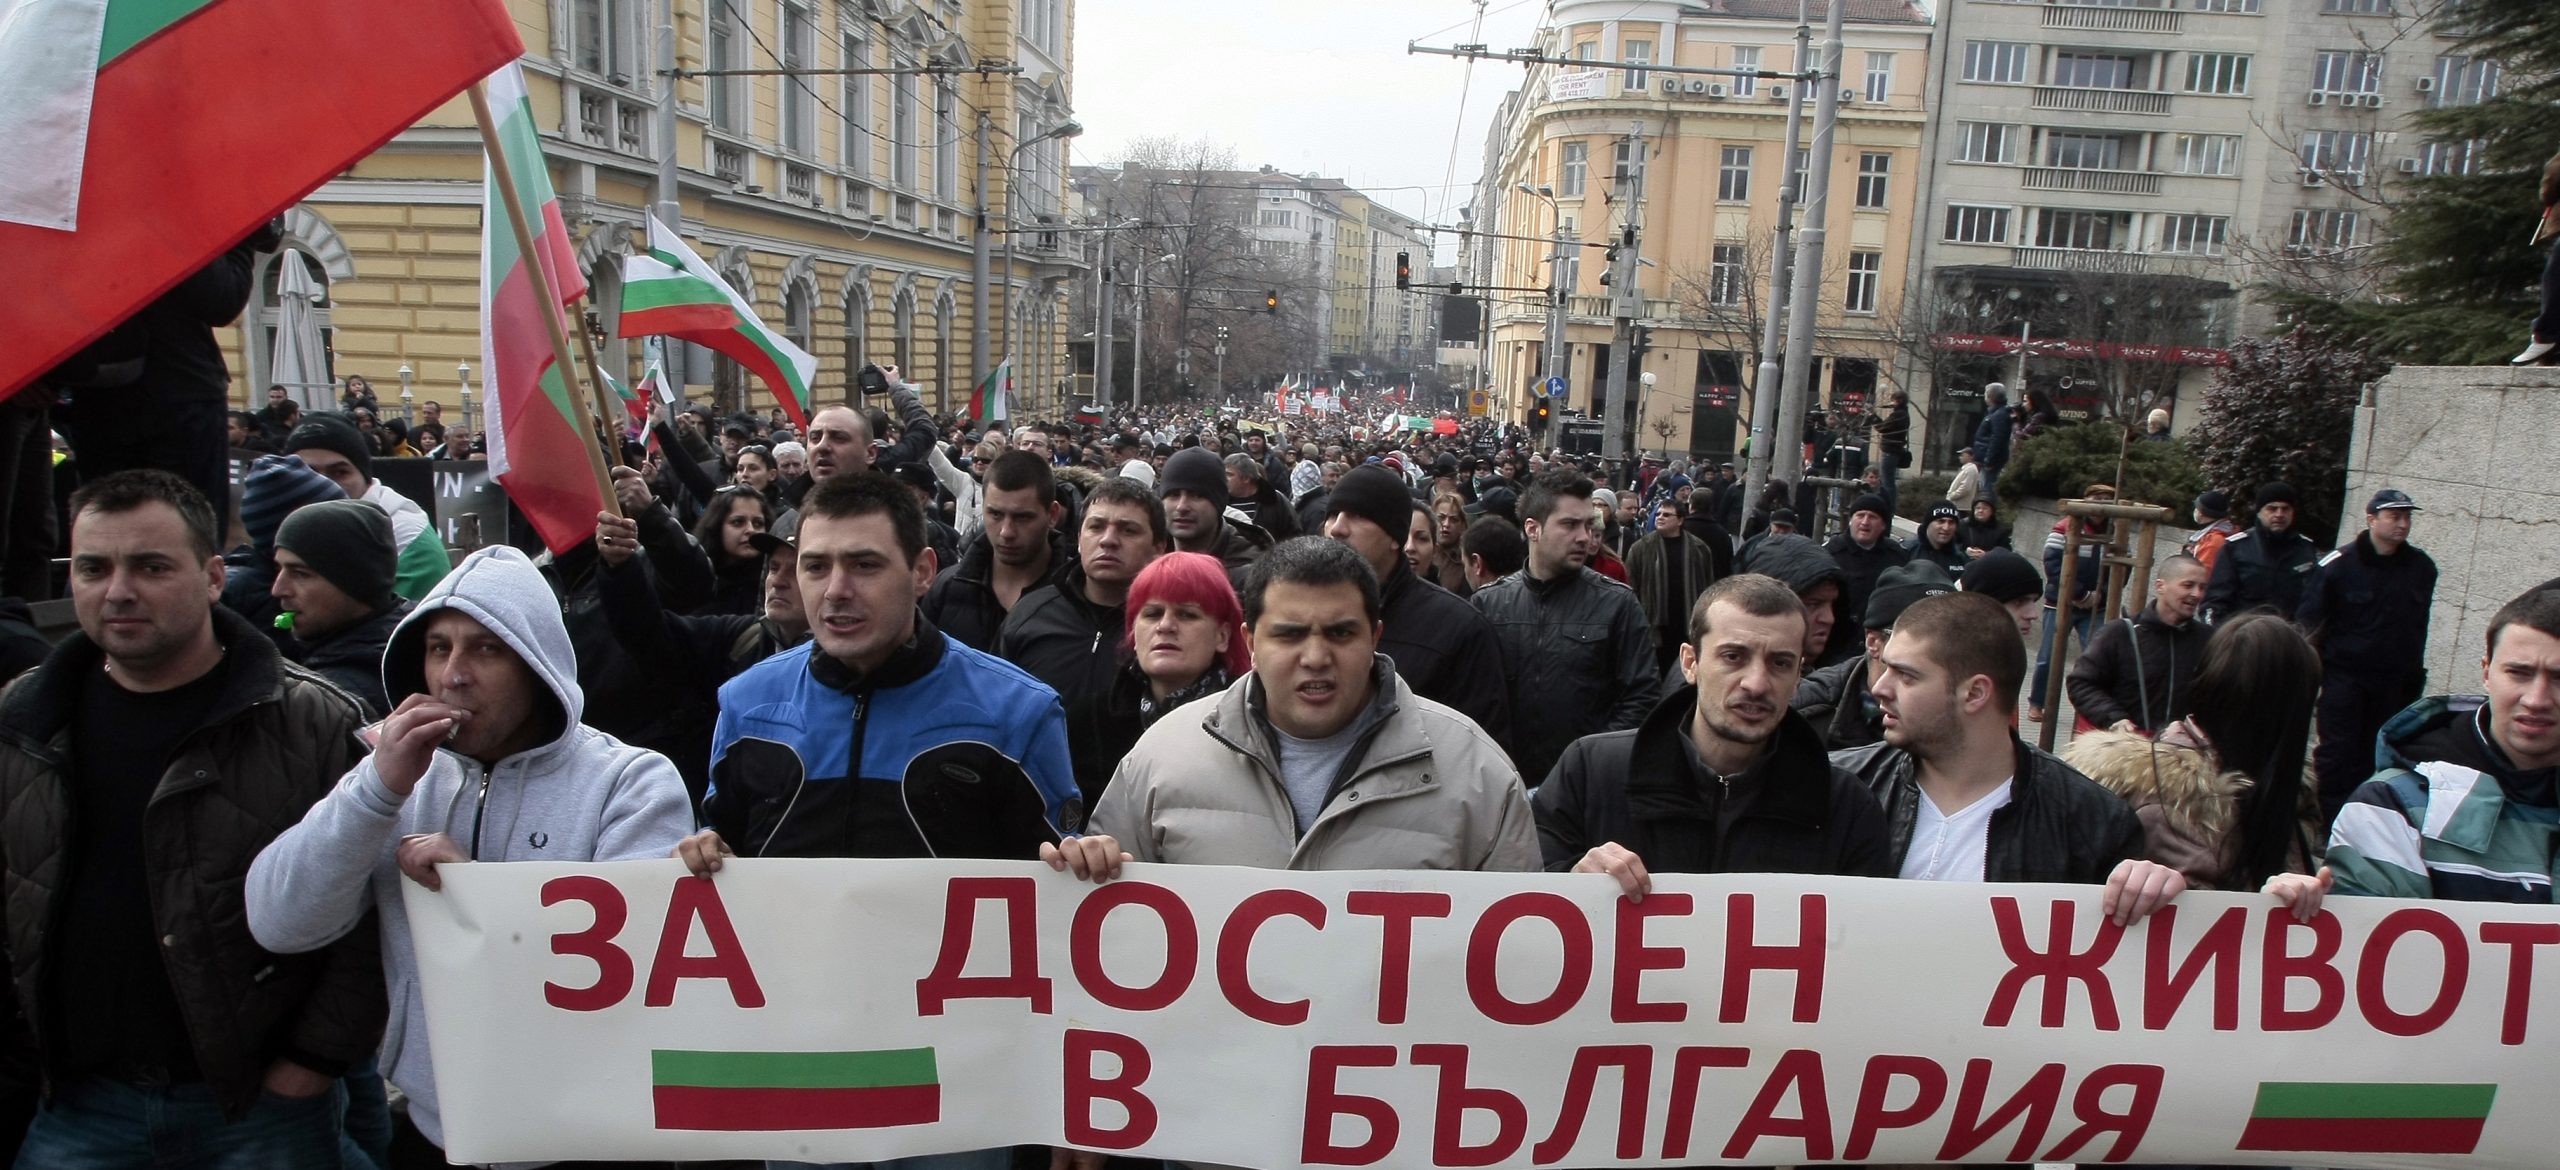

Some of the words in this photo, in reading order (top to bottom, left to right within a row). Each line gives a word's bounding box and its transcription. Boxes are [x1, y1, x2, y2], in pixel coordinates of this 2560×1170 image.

[2058, 410, 2088, 419] AVINO
[1933, 507, 1959, 517] POLI
[541, 876, 766, 1011] ЗА
[916, 877, 1827, 1025] ДОСТОЕН
[1983, 896, 2560, 1045] ЖИВОТ
[1063, 1028, 1159, 1149] В
[1301, 1043, 2165, 1167] БЪЛГАРИЯ
